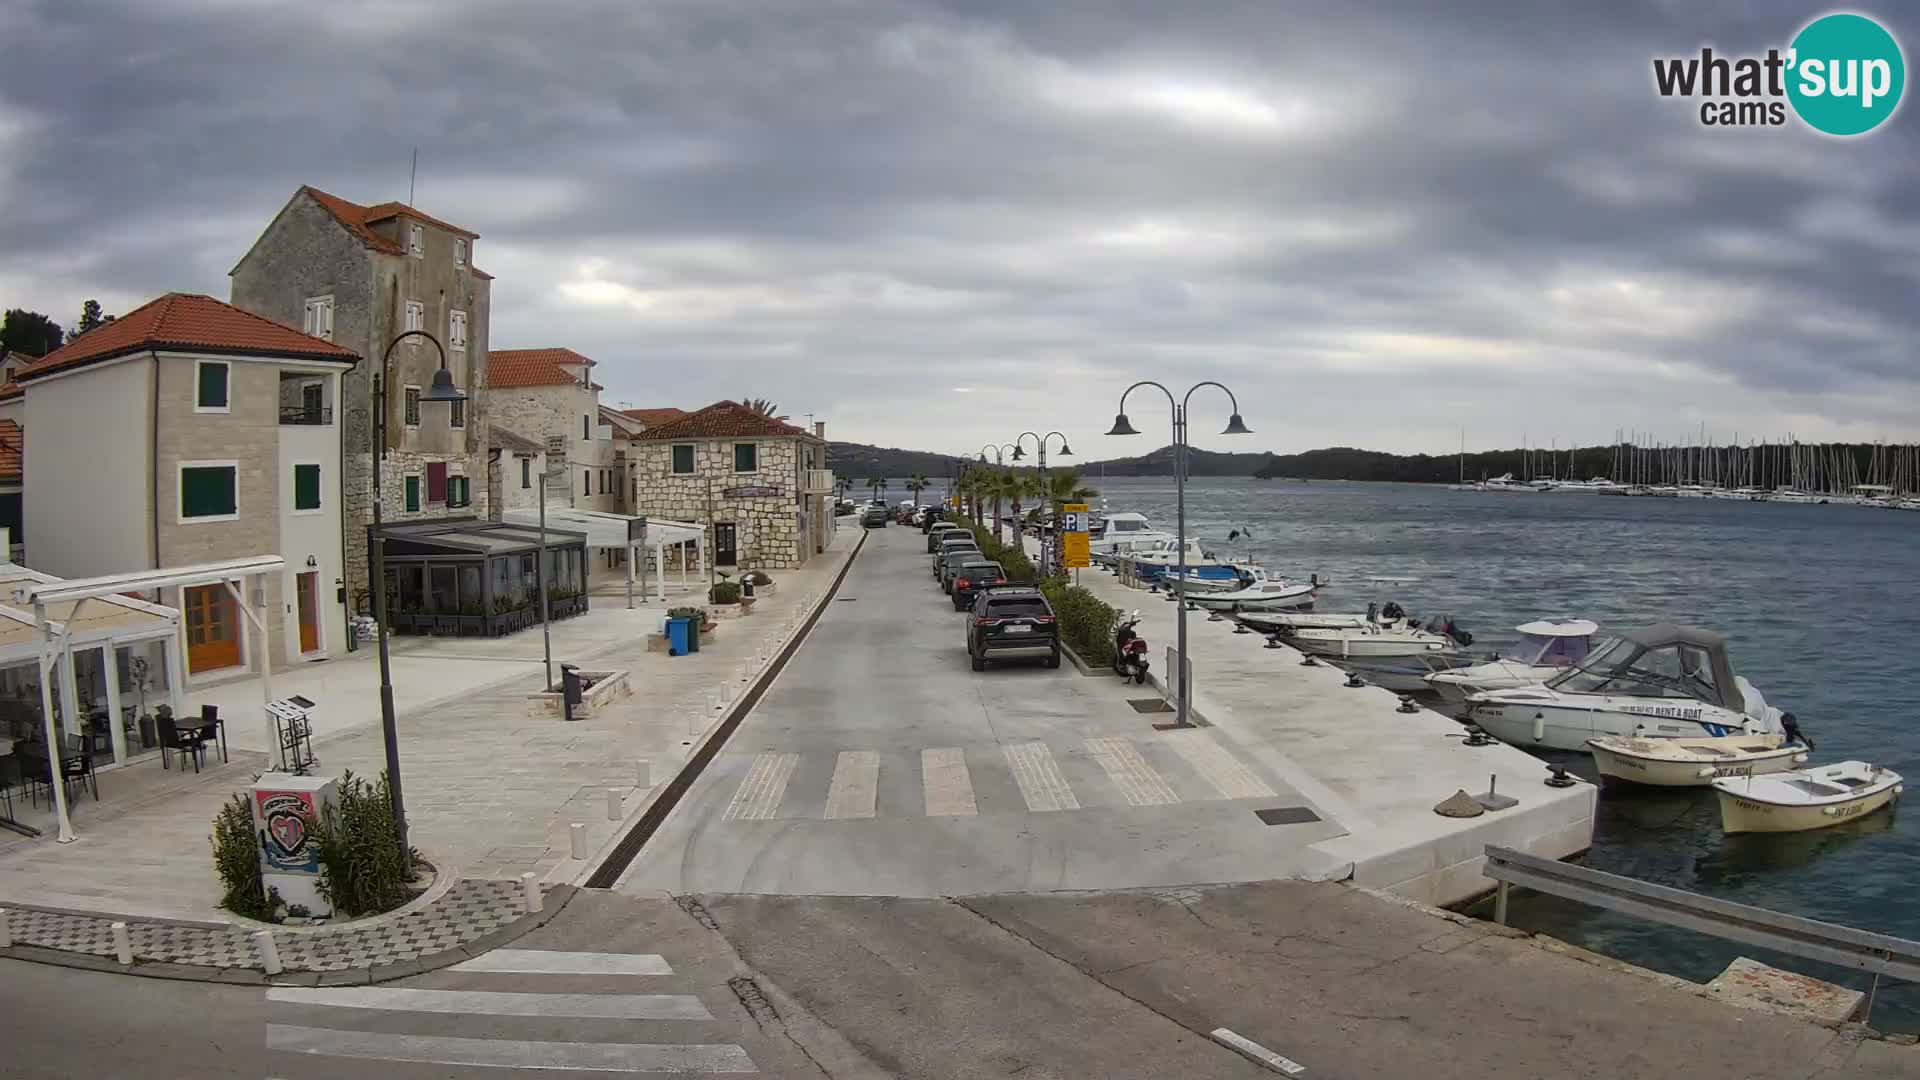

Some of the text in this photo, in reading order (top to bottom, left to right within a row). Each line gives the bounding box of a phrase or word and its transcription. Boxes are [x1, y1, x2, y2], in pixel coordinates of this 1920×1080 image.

[1066, 514, 1077, 530] P
[1655, 705, 1676, 717] RENT
[1683, 708, 1702, 720] BOAT
